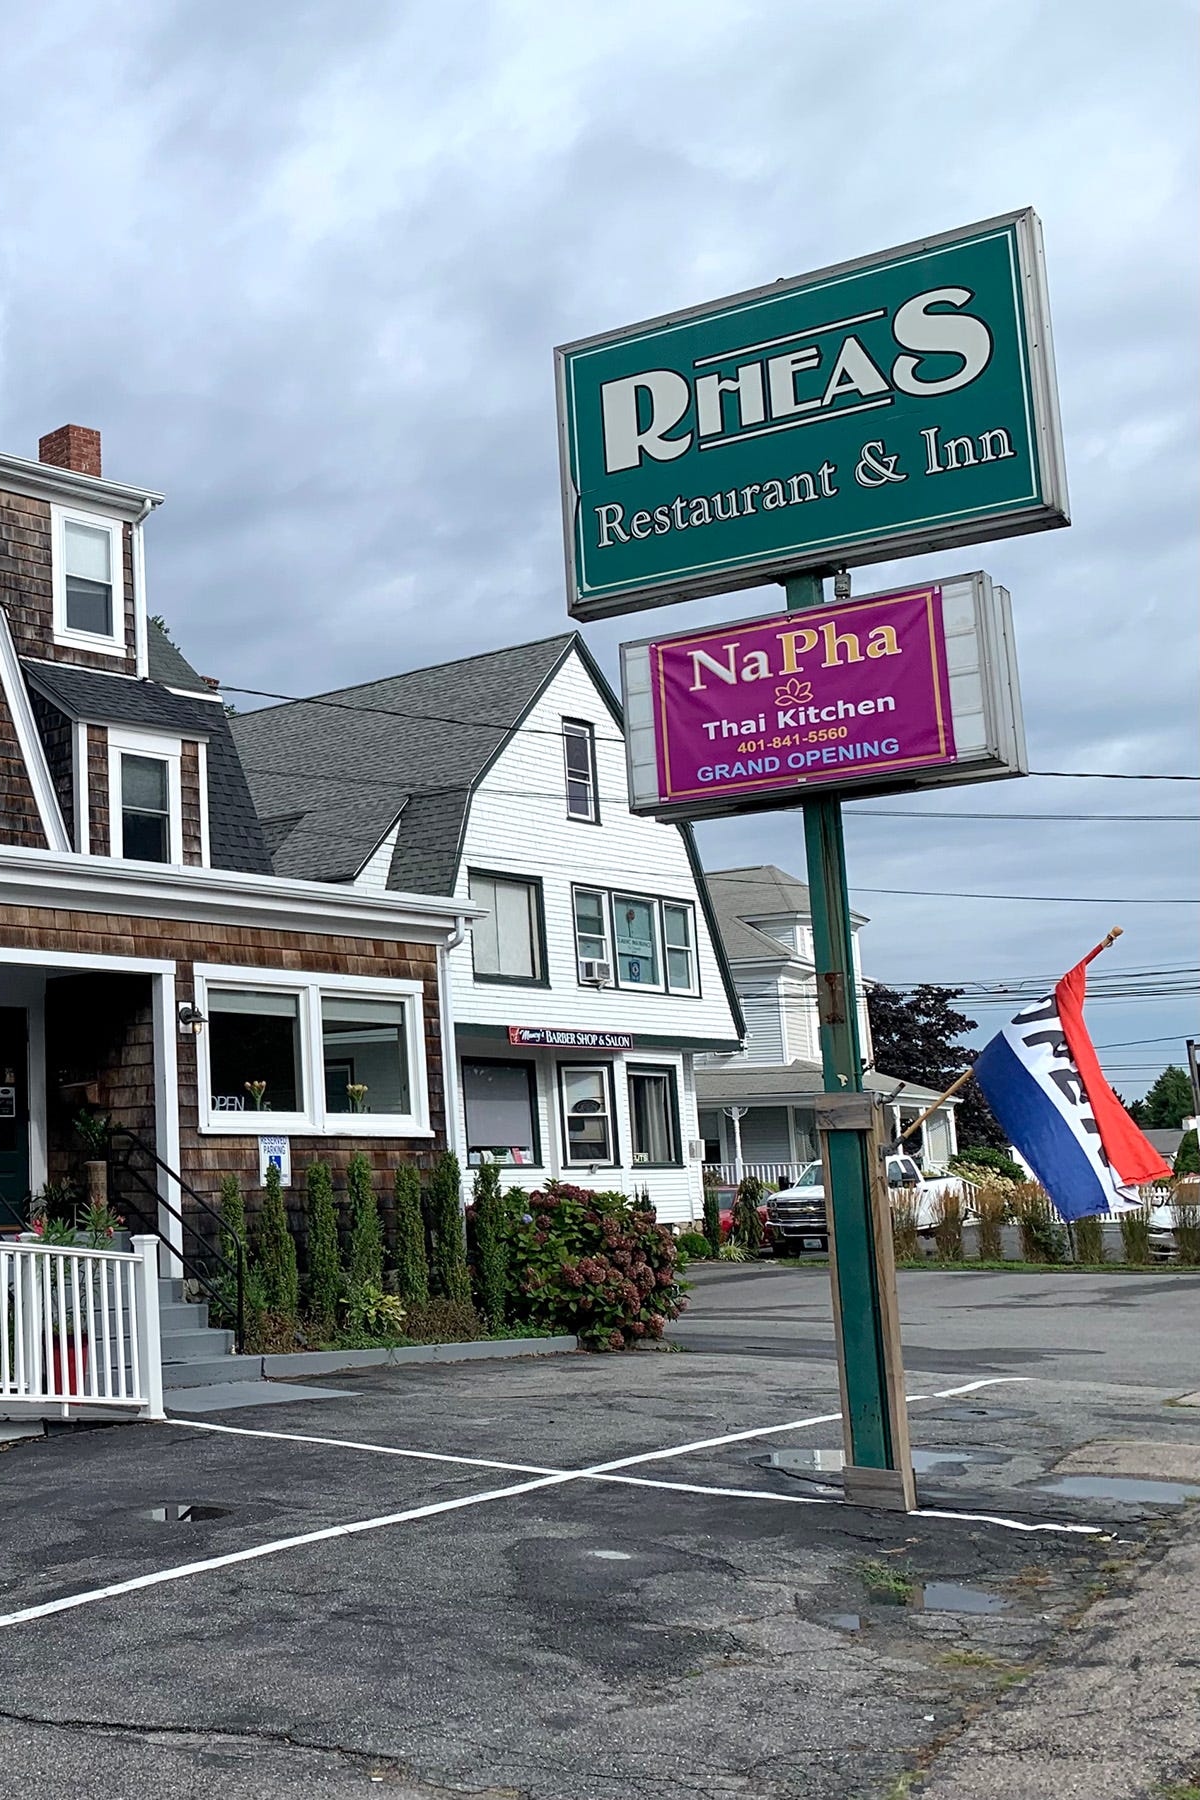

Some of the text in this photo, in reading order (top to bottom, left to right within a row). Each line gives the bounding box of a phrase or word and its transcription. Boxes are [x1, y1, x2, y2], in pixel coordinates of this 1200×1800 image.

[595, 426, 1015, 549] Restaurant & Inn
[687, 621, 902, 692] Na Pha
[702, 693, 896, 740] Thai Kitchen
[737, 726, 848, 754] 401-841-5560
[697, 737, 900, 782] GRAND OPENING
[546, 1030, 576, 1045] BARBER
[577, 1033, 598, 1046] SHOP
[599, 1035, 605, 1045] &
[605, 1035, 630, 1047] SALON
[261, 1136, 287, 1145] RESERVED
[264, 1145, 286, 1155] PARKING
